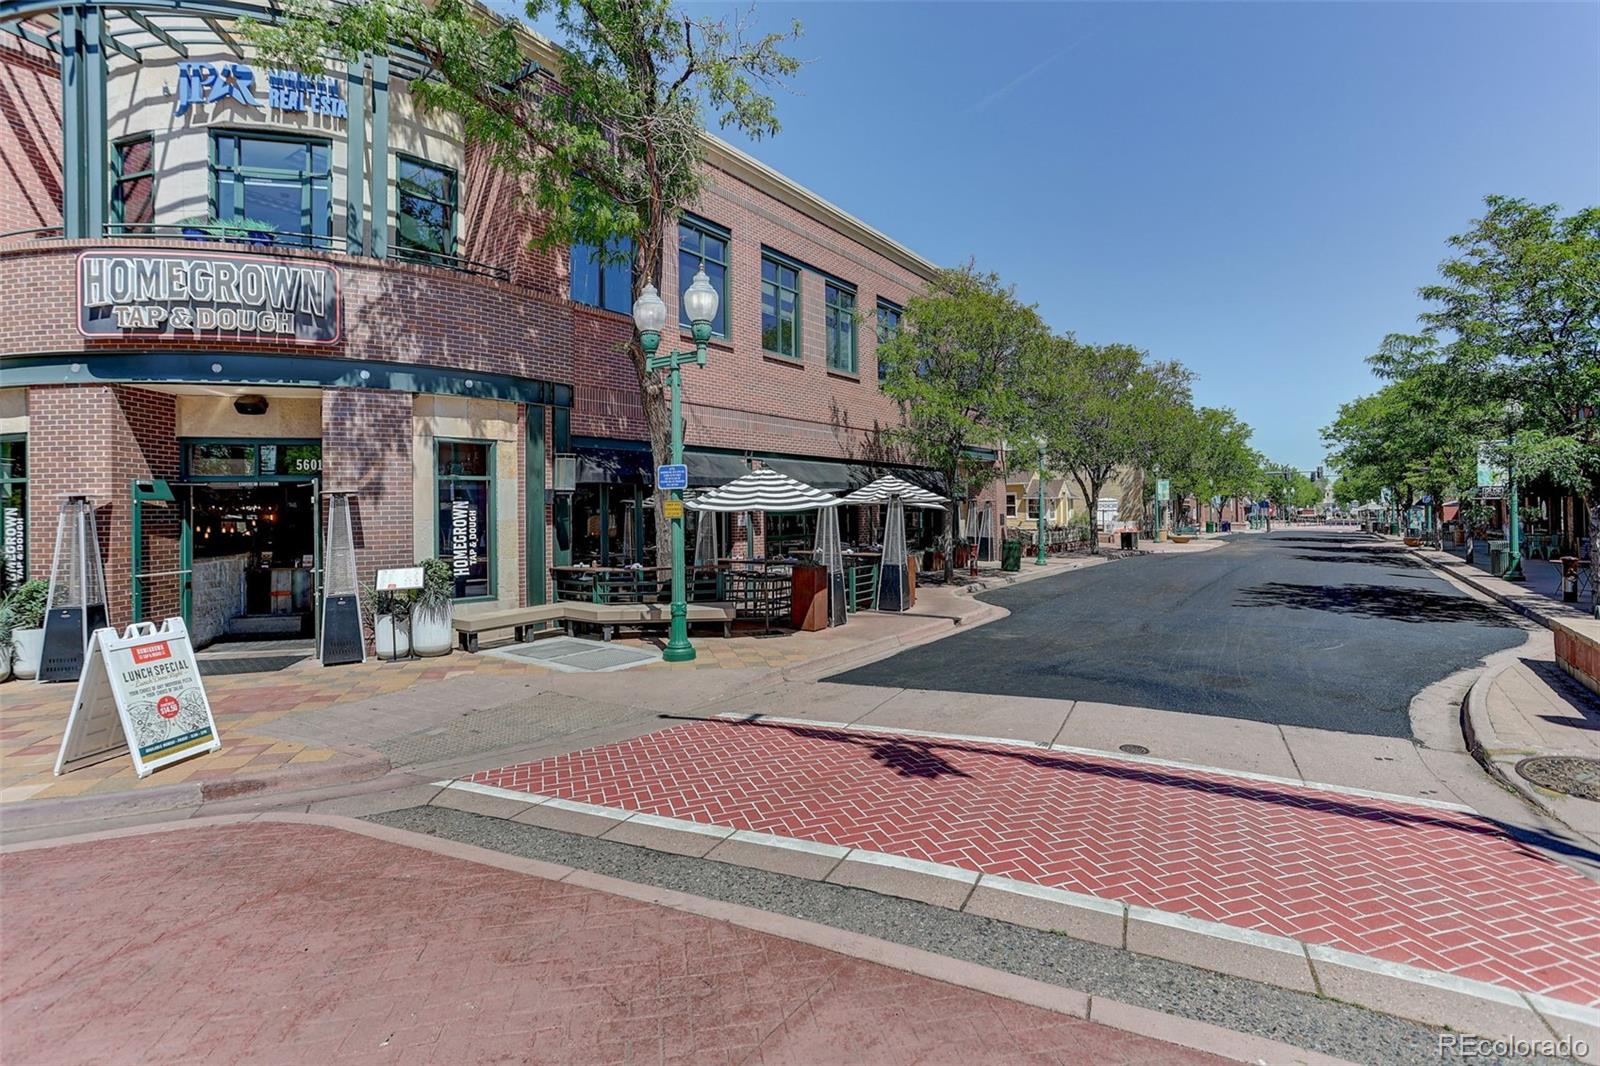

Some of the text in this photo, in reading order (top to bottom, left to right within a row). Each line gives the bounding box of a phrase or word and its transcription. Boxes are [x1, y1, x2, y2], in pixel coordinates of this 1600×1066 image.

[268, 88, 348, 118] REAL ESTA
[82, 257, 326, 317] HOMEGROWN
[112, 306, 295, 334] TAP & DOUGH
[296, 459, 323, 471] 5601
[452, 501, 470, 577] HOMEGROWN
[469, 510, 477, 566] TAP & DOUGH
[122, 660, 189, 683] LUNCH SPECIAL
